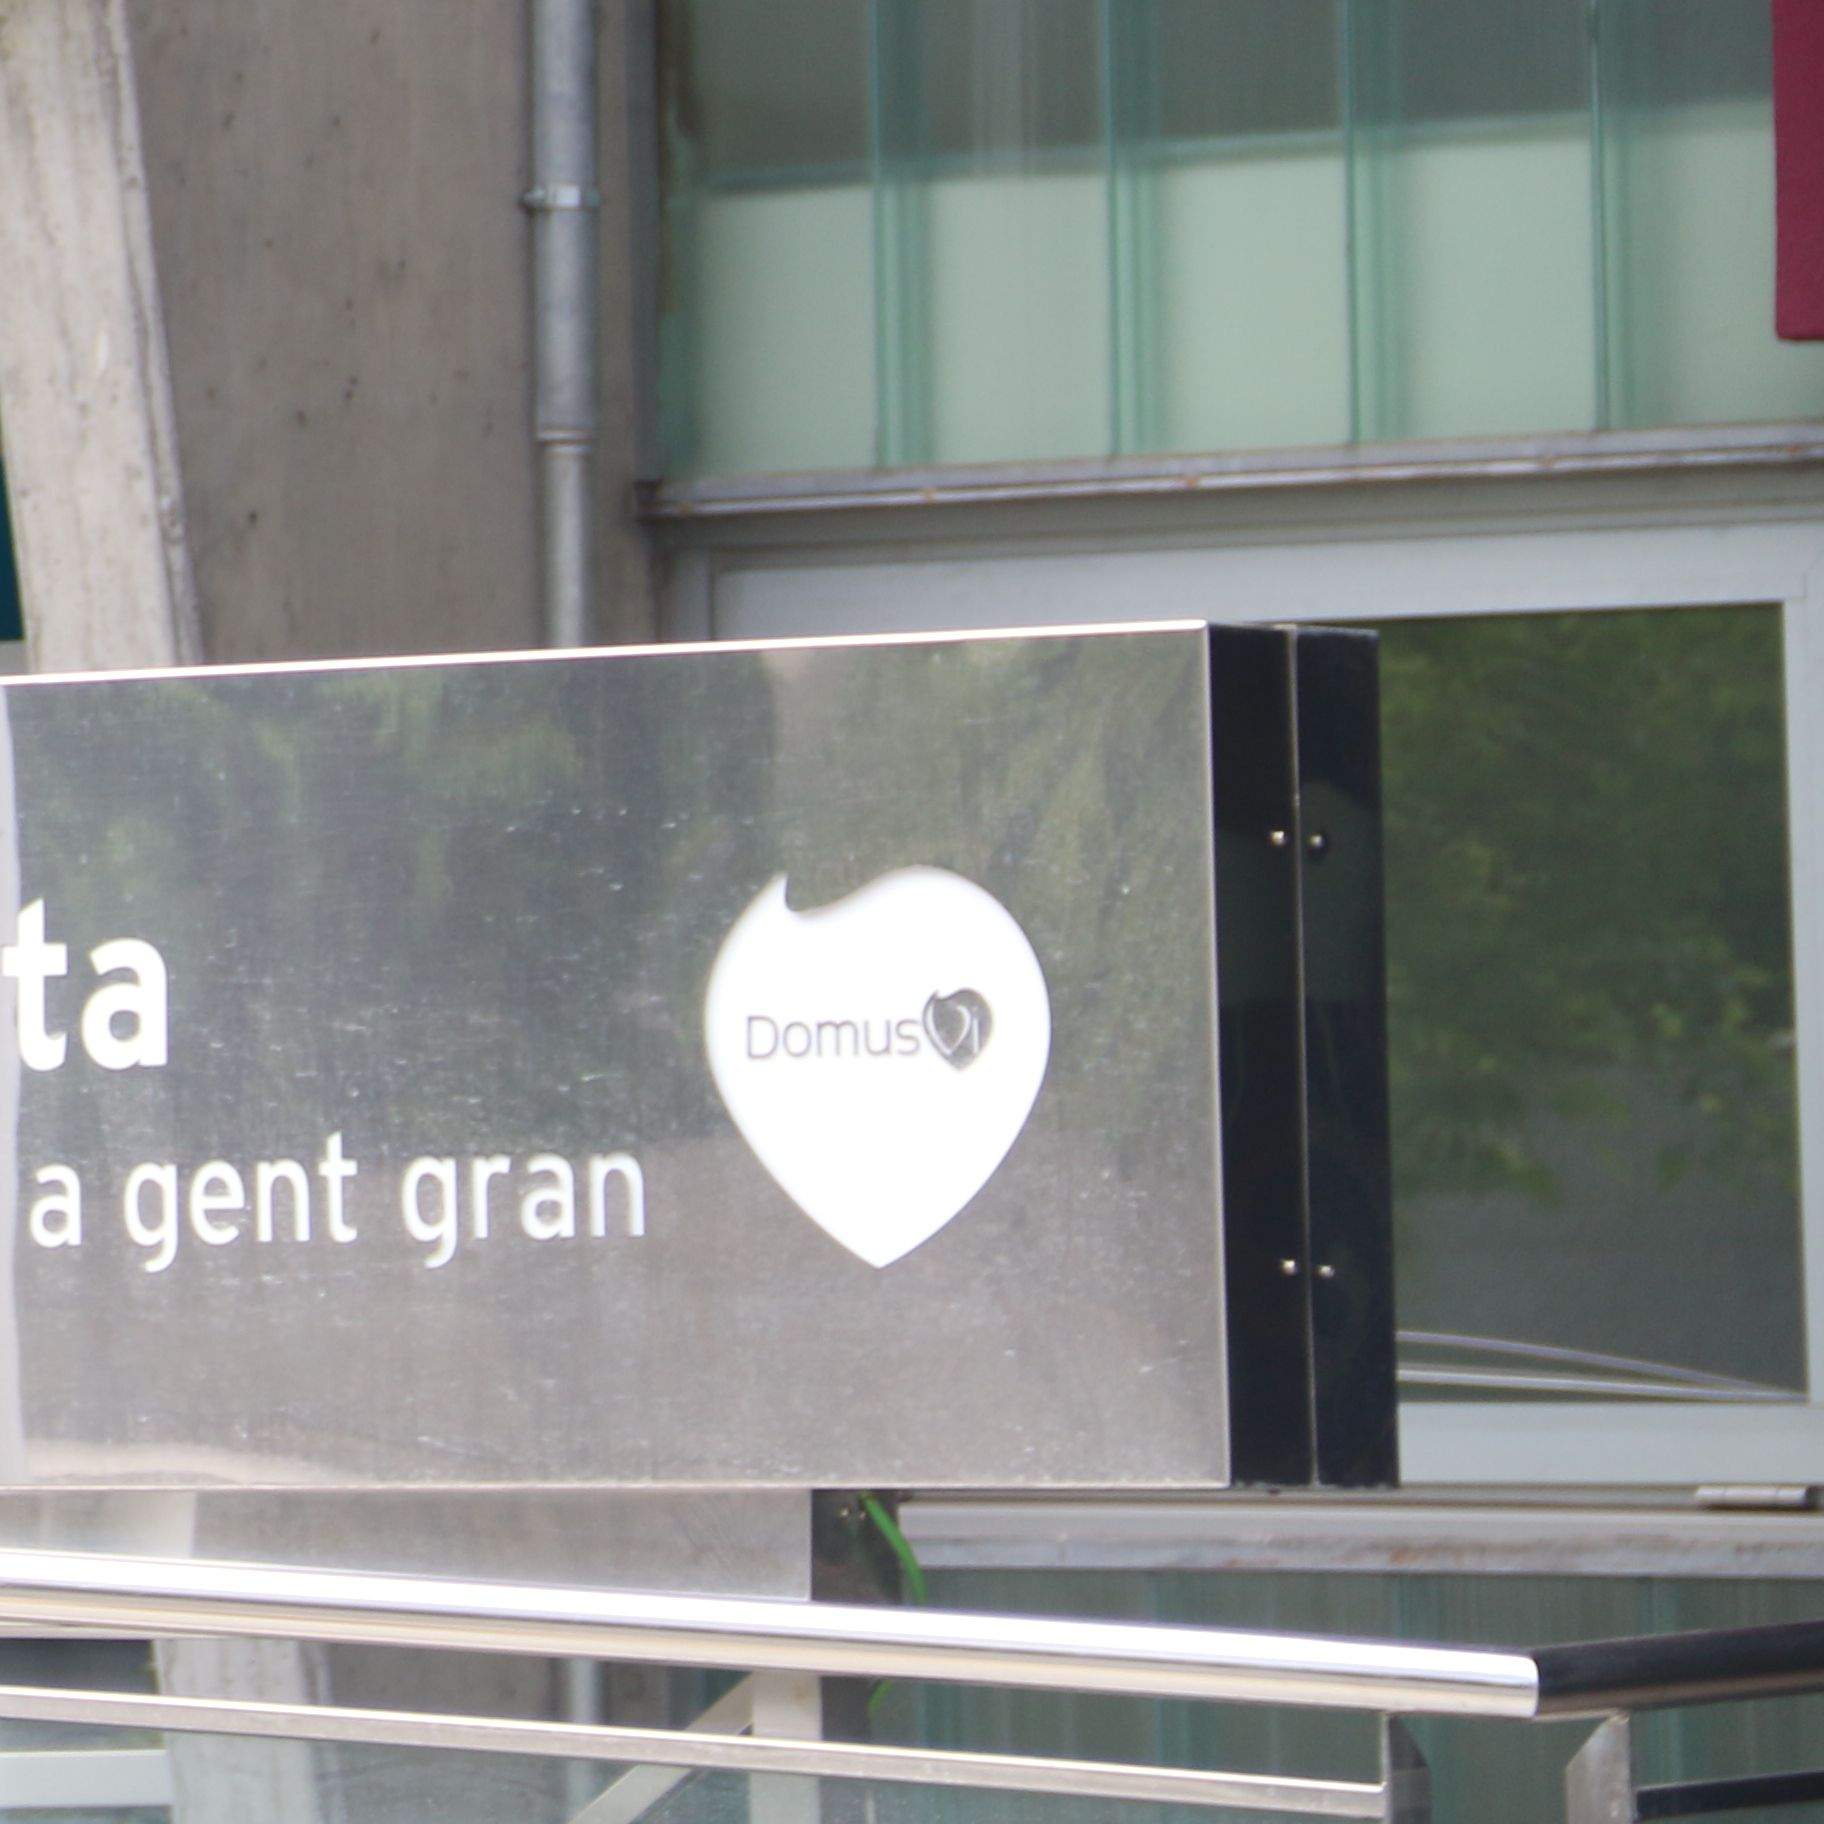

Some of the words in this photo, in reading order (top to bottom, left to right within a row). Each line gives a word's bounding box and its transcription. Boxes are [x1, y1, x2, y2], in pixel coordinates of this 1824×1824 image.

[29, 1163, 82, 1248] a
[123, 1131, 358, 1273] gent
[401, 1153, 645, 1268] gran
